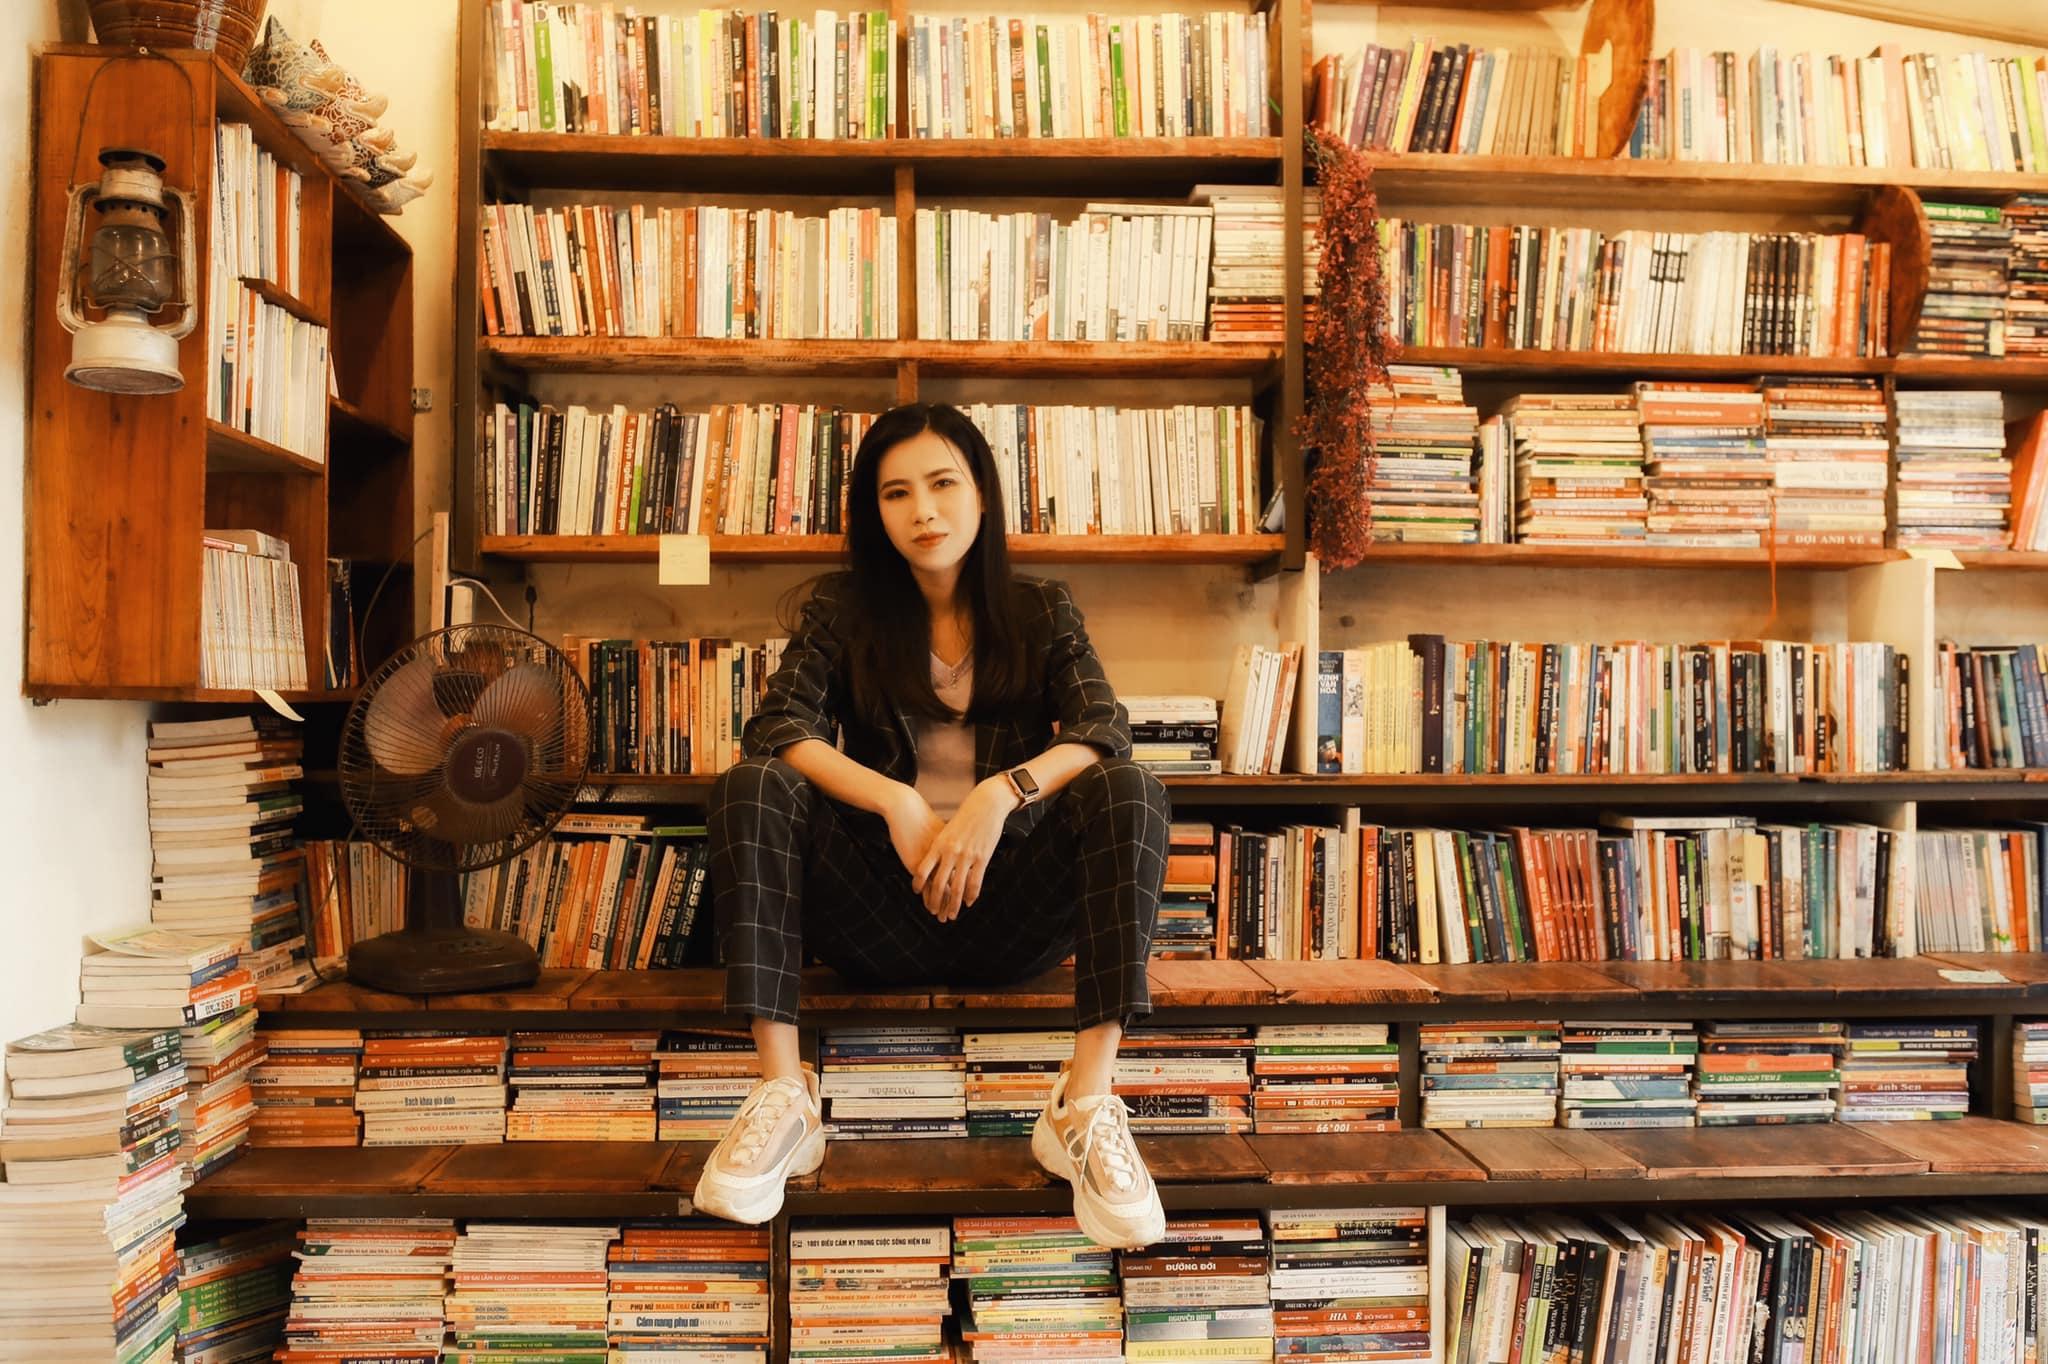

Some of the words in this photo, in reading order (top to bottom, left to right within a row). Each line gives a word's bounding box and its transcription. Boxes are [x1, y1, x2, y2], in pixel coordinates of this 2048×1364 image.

[1795, 535, 1816, 546] ĐỢI
[1820, 534, 1845, 544] ANH
[1328, 875, 1334, 890] em
[908, 1238, 920, 1246] HIỆN
[1166, 1263, 1198, 1271] ĐƯỜNG
[1200, 1262, 1216, 1270] ĐỜI
[1640, 1276, 1649, 1300] Truyện
[637, 1316, 653, 1327] Cẩm
[654, 1318, 672, 1328] nang
[674, 1317, 688, 1328] phụ
